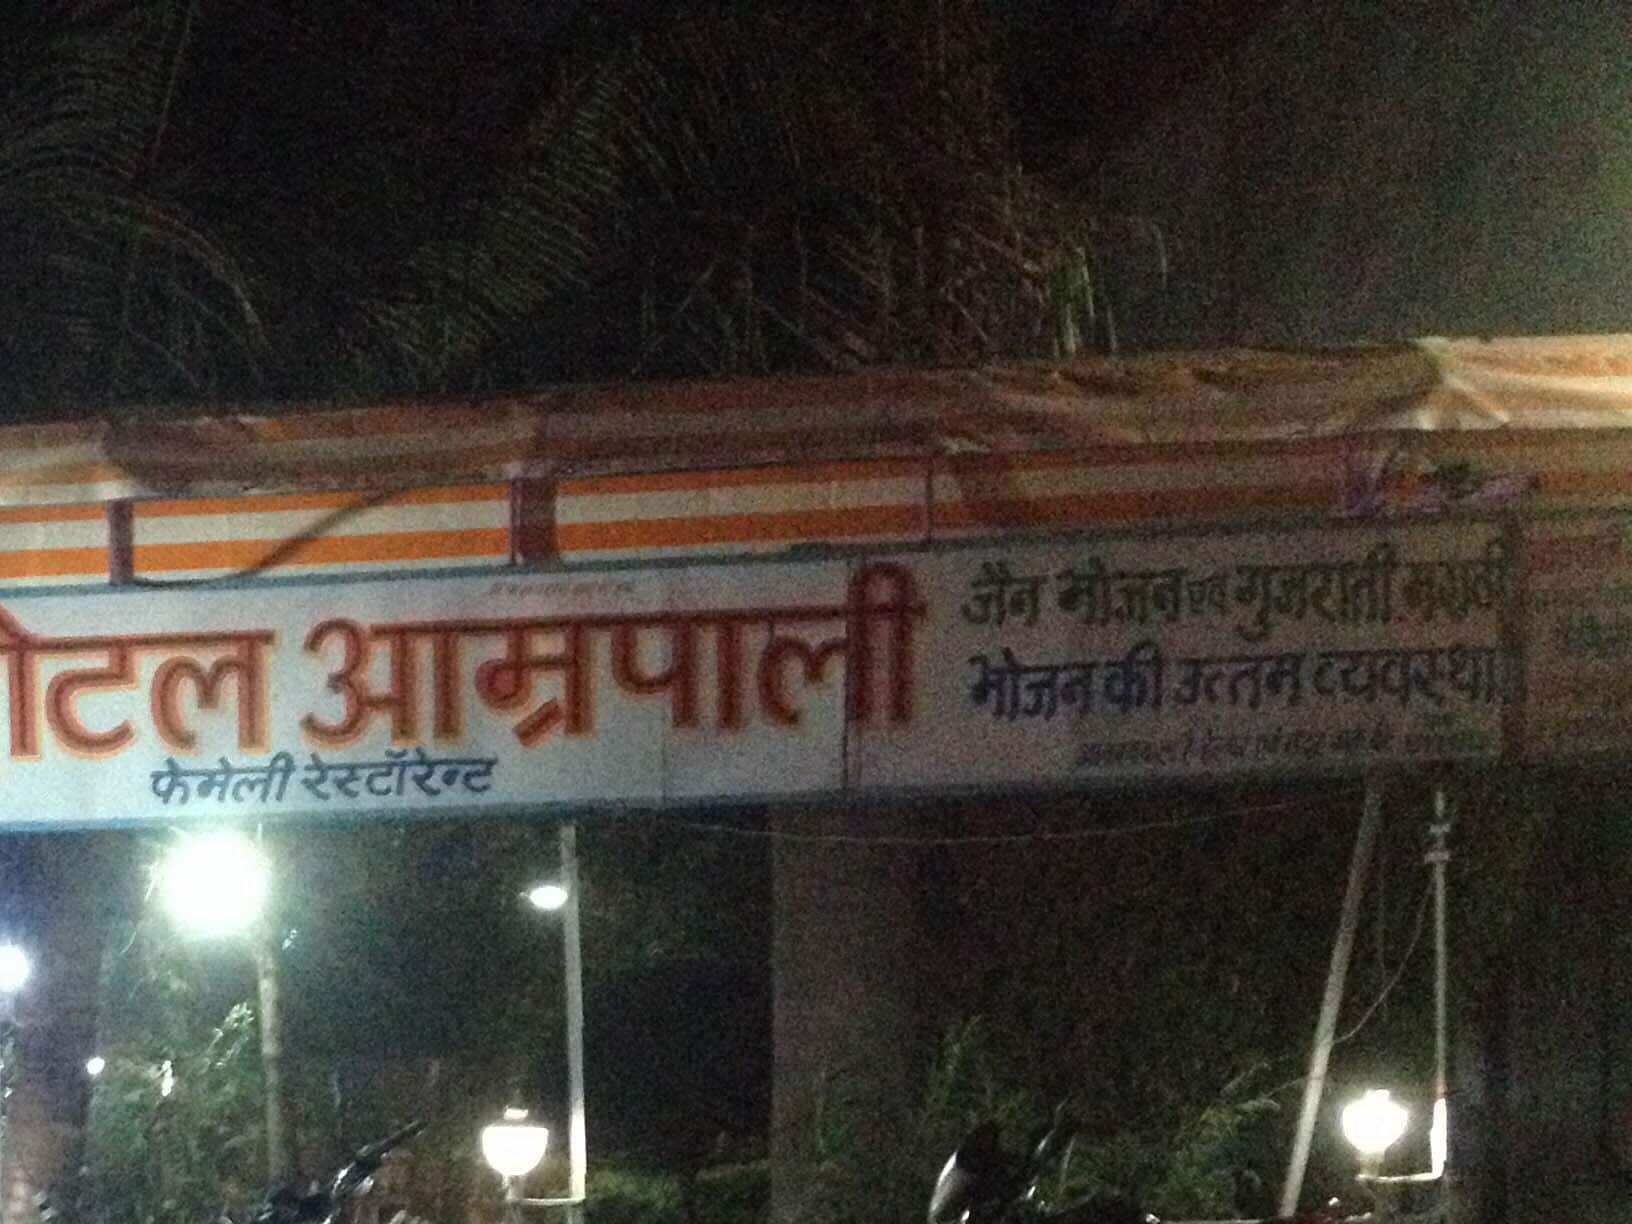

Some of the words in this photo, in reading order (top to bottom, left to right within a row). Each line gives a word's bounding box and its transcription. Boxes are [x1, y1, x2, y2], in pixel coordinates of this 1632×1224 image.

[960, 561, 1045, 627] जैन
[299, 560, 928, 749] आम्रपाली
[967, 650, 1094, 720] भोजन
[1102, 640, 1162, 715] की
